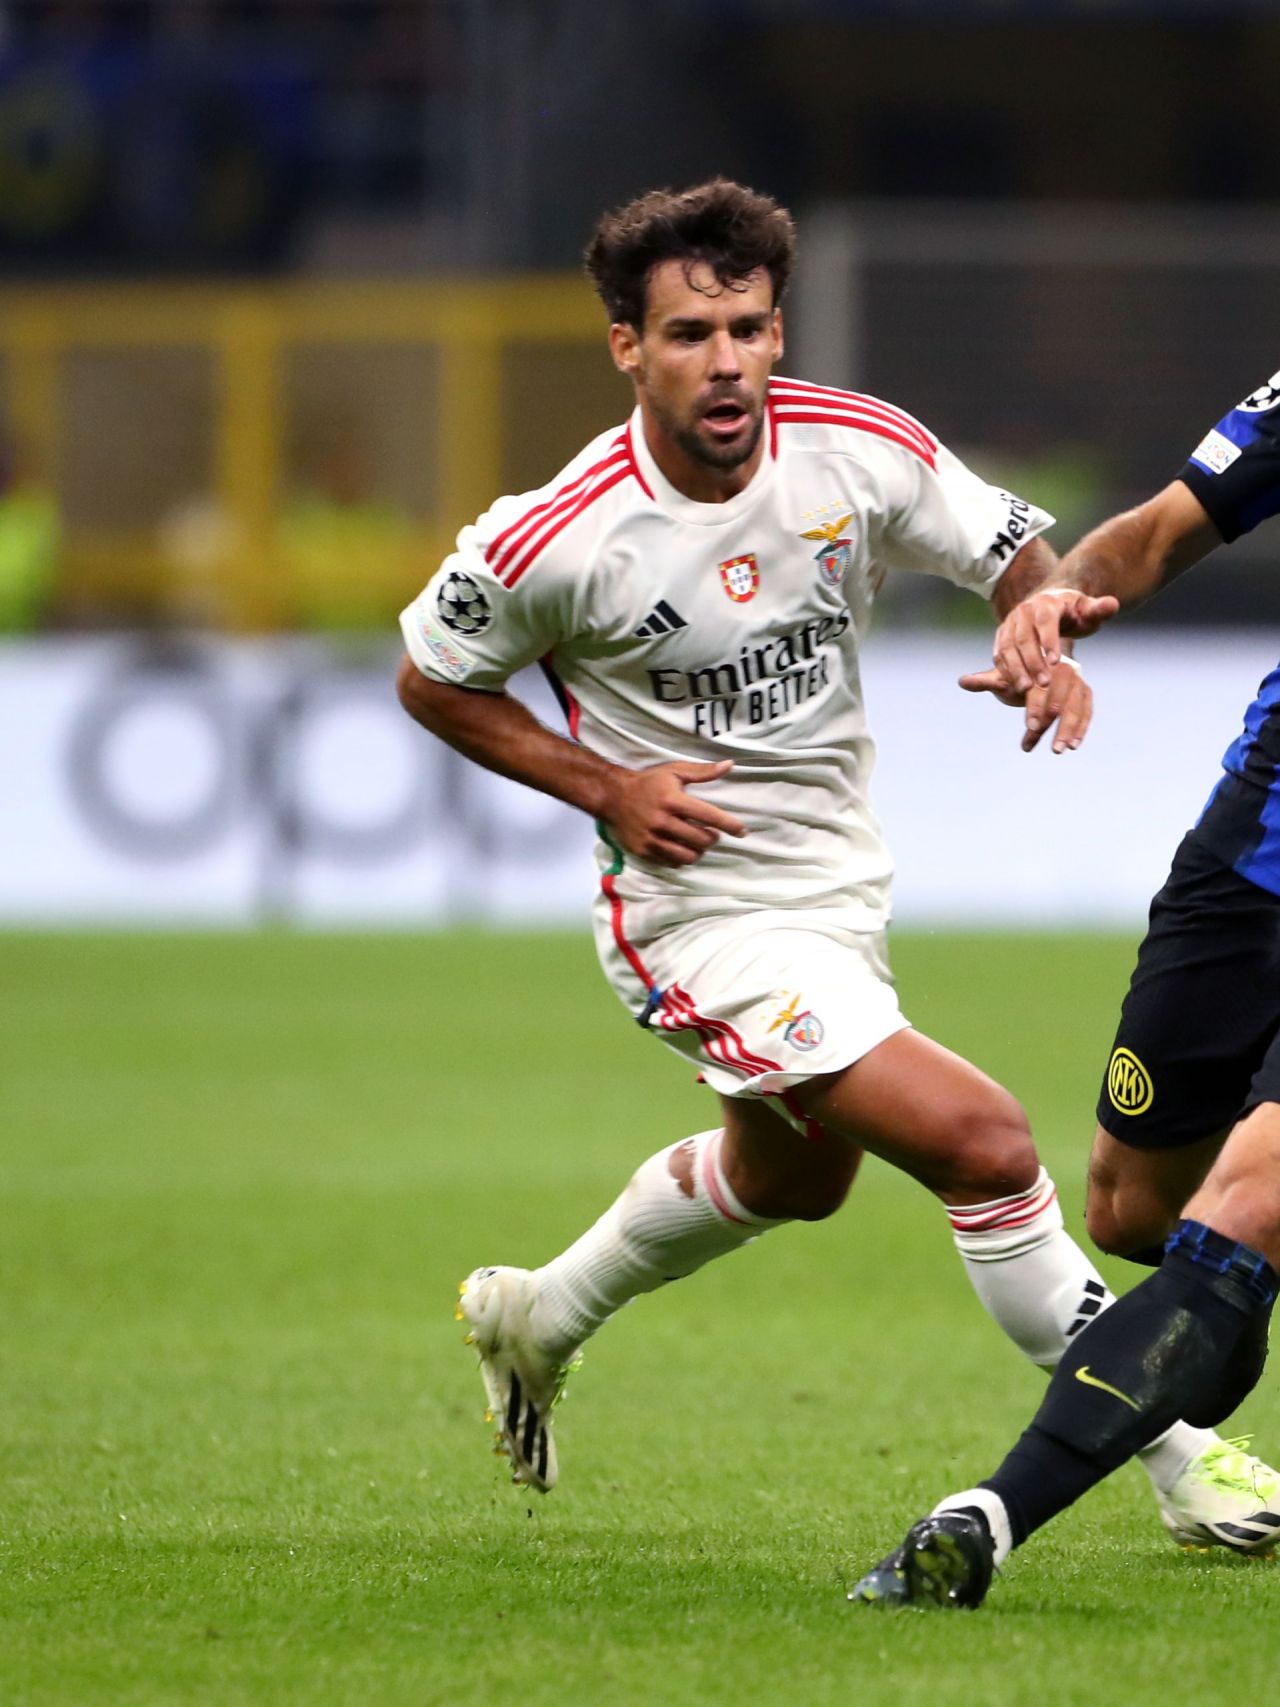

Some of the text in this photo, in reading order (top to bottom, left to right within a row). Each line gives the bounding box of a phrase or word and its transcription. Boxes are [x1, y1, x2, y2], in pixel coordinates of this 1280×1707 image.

[647, 605, 849, 702] Emirates
[694, 654, 829, 737] FLY BETTER
